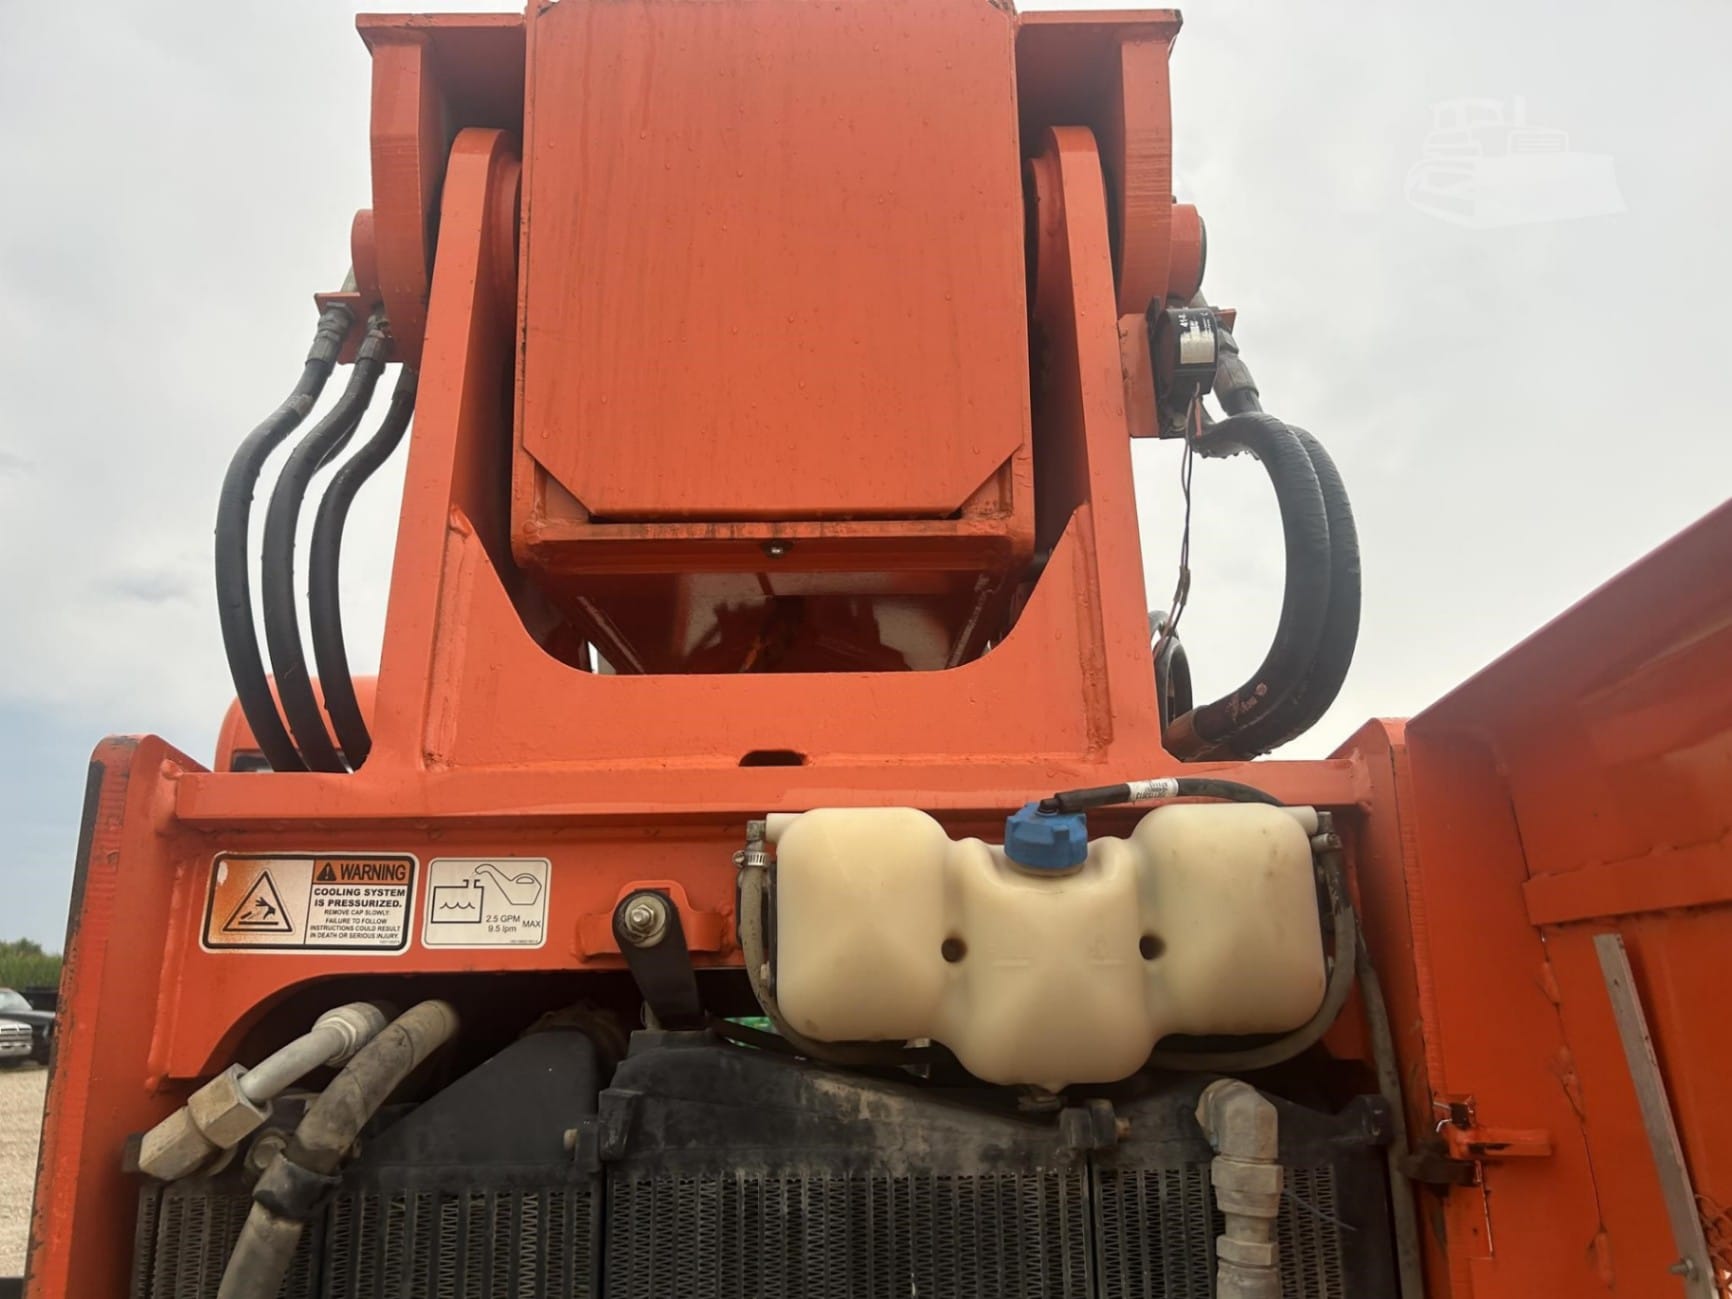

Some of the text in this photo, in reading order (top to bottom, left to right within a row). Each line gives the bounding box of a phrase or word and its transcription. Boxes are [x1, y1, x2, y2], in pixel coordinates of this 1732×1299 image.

[340, 863, 406, 880] WARNING
[314, 888, 405, 896] COOLING SYSTEM
[314, 899, 402, 907] IS PRESSURIZED.
[486, 914, 520, 923] 2.5 GPM
[488, 924, 500, 932] 9.5
[523, 920, 541, 928] MAX
